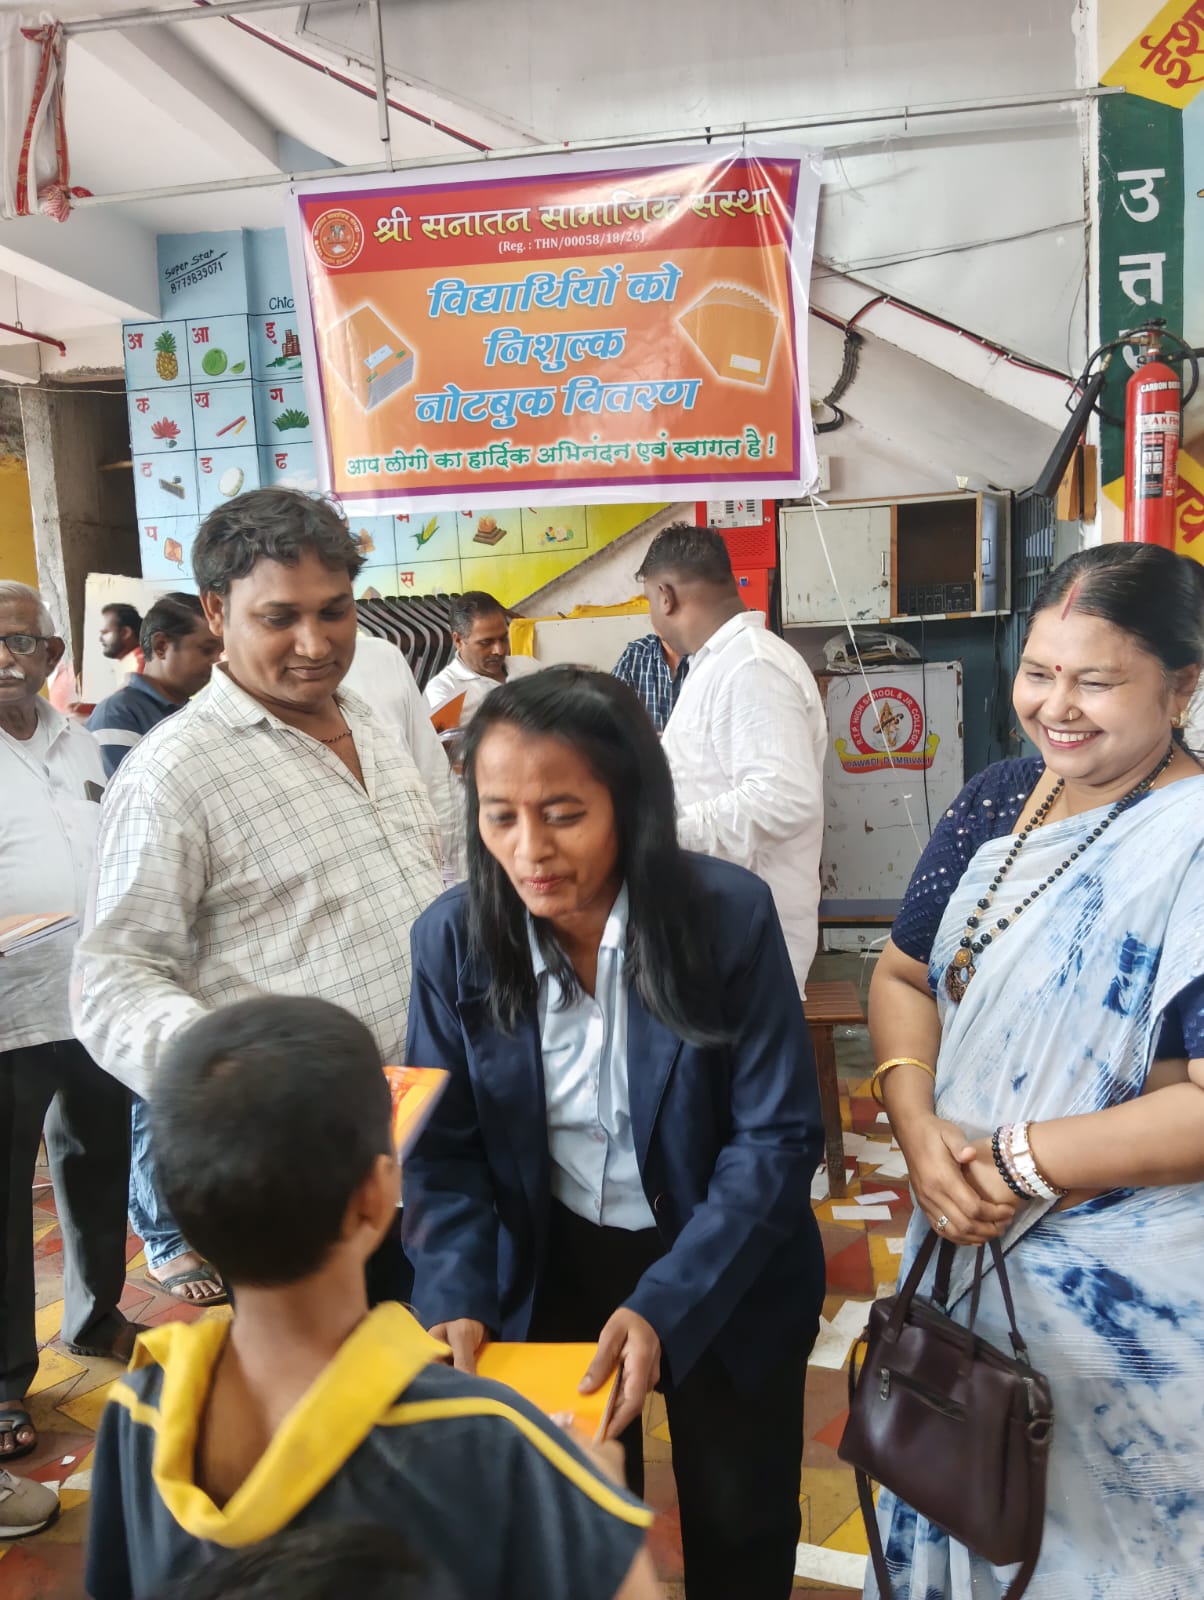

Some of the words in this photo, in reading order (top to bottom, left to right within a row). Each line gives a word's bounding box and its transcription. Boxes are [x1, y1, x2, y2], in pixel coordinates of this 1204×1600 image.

[373, 206, 412, 243] श्री
[419, 207, 532, 239] सनातन
[538, 189, 681, 231] सामाजिक
[164, 261, 188, 280] Super
[191, 248, 215, 266] Star
[427, 263, 624, 317] विद्यार्थियों
[627, 260, 683, 302] को
[128, 333, 143, 350] अ
[192, 326, 209, 344] आ
[483, 326, 627, 373] निशुल्क
[194, 391, 209, 408] ख
[270, 387, 284, 403] ग
[414, 383, 556, 429] नोटबुक
[561, 375, 704, 416] वितरण
[136, 397, 150, 413] क
[346, 457, 380, 476] आप
[384, 448, 429, 473] लोगो
[434, 450, 464, 469] का
[467, 441, 531, 470] हार्दिक
[536, 435, 632, 463] अभिनंदन
[636, 432, 667, 462] एवं
[672, 438, 742, 460] स्वागत
[744, 427, 761, 458] है
[200, 456, 213, 474] ड
[145, 526, 158, 541] प
[400, 571, 415, 588] स
[907, 708, 920, 746] COLLEGE
